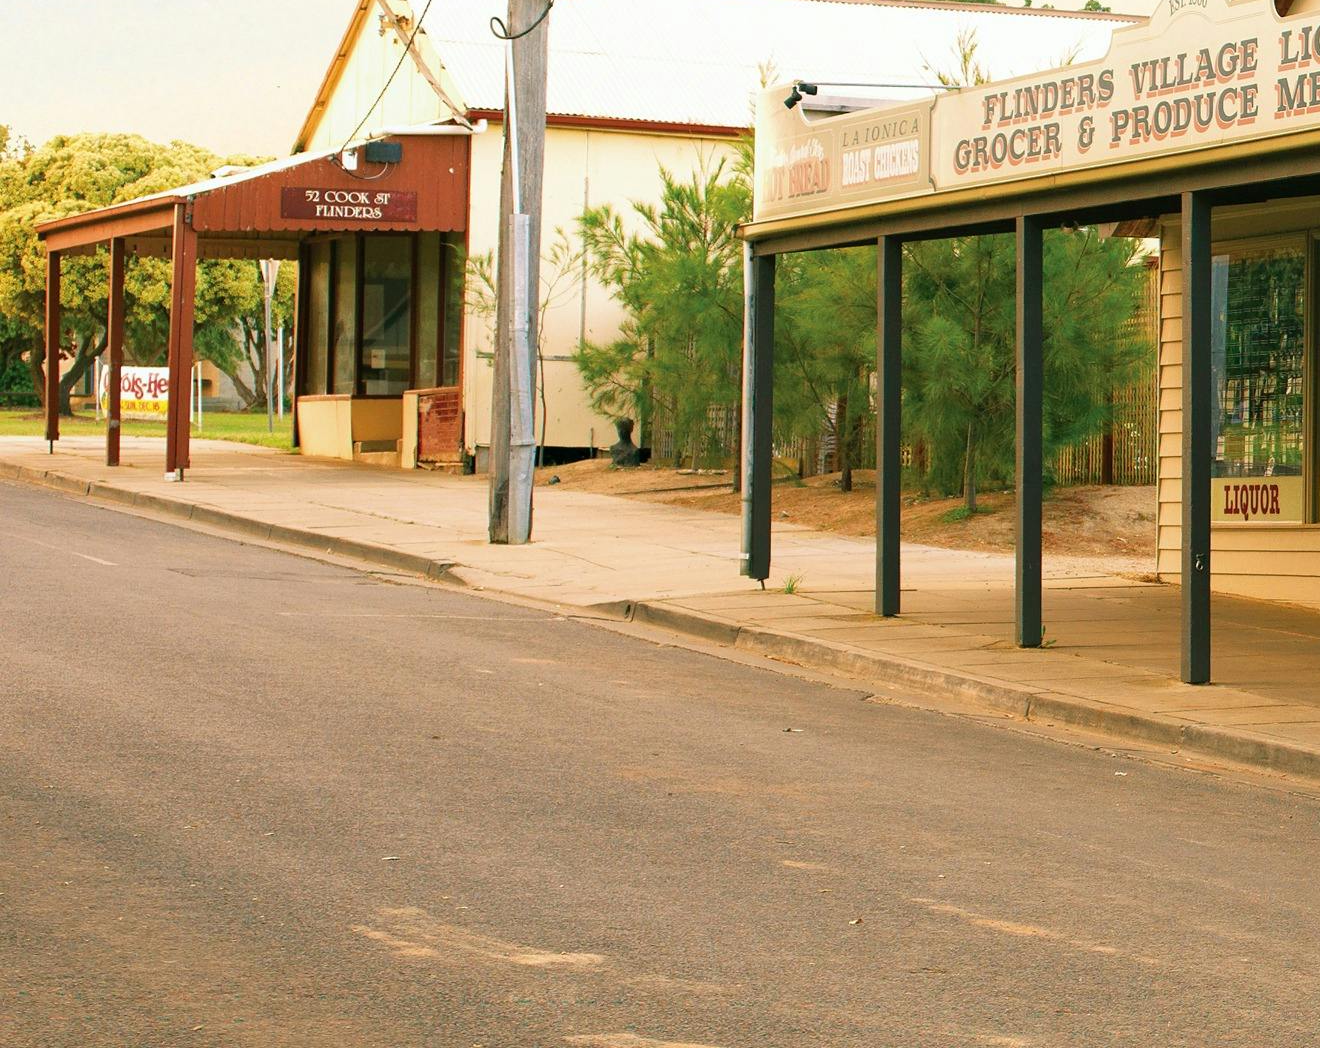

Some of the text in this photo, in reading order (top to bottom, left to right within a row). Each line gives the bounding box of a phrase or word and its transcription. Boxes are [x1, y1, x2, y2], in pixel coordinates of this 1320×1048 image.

[982, 68, 1116, 128] FLINDERS
[1129, 37, 1261, 94] VILLAGE
[953, 120, 1064, 176] GROCER
[1076, 118, 1097, 152] &
[1109, 84, 1261, 149] PRODUCE
[874, 138, 920, 182] CHICKENS
[305, 190, 391, 204] 52 COOK ST
[316, 205, 382, 219] FLINDERS
[1223, 484, 1280, 521] LIQUOR
